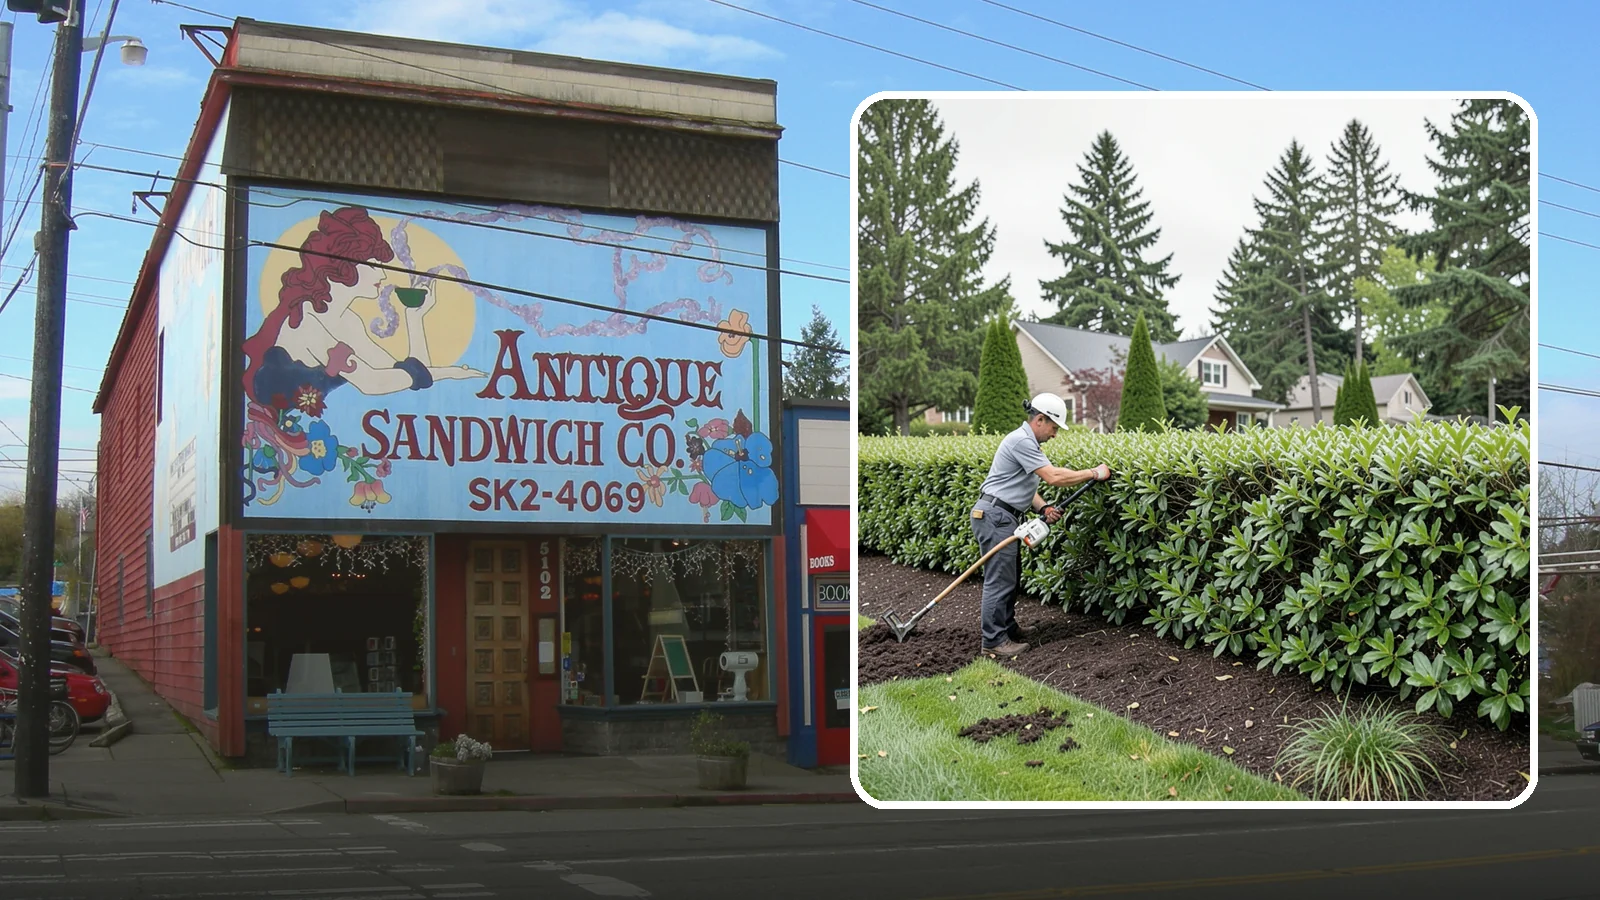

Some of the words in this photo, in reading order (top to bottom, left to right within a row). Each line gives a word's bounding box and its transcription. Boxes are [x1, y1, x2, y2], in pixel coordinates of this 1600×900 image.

[476, 329, 723, 420] ANTIQUE
[361, 408, 604, 467] SANDWICH
[617, 422, 685, 469] CO.
[468, 477, 646, 513] SK2-4069
[539, 540, 552, 600] 5102
[809, 555, 835, 569] BOOKS
